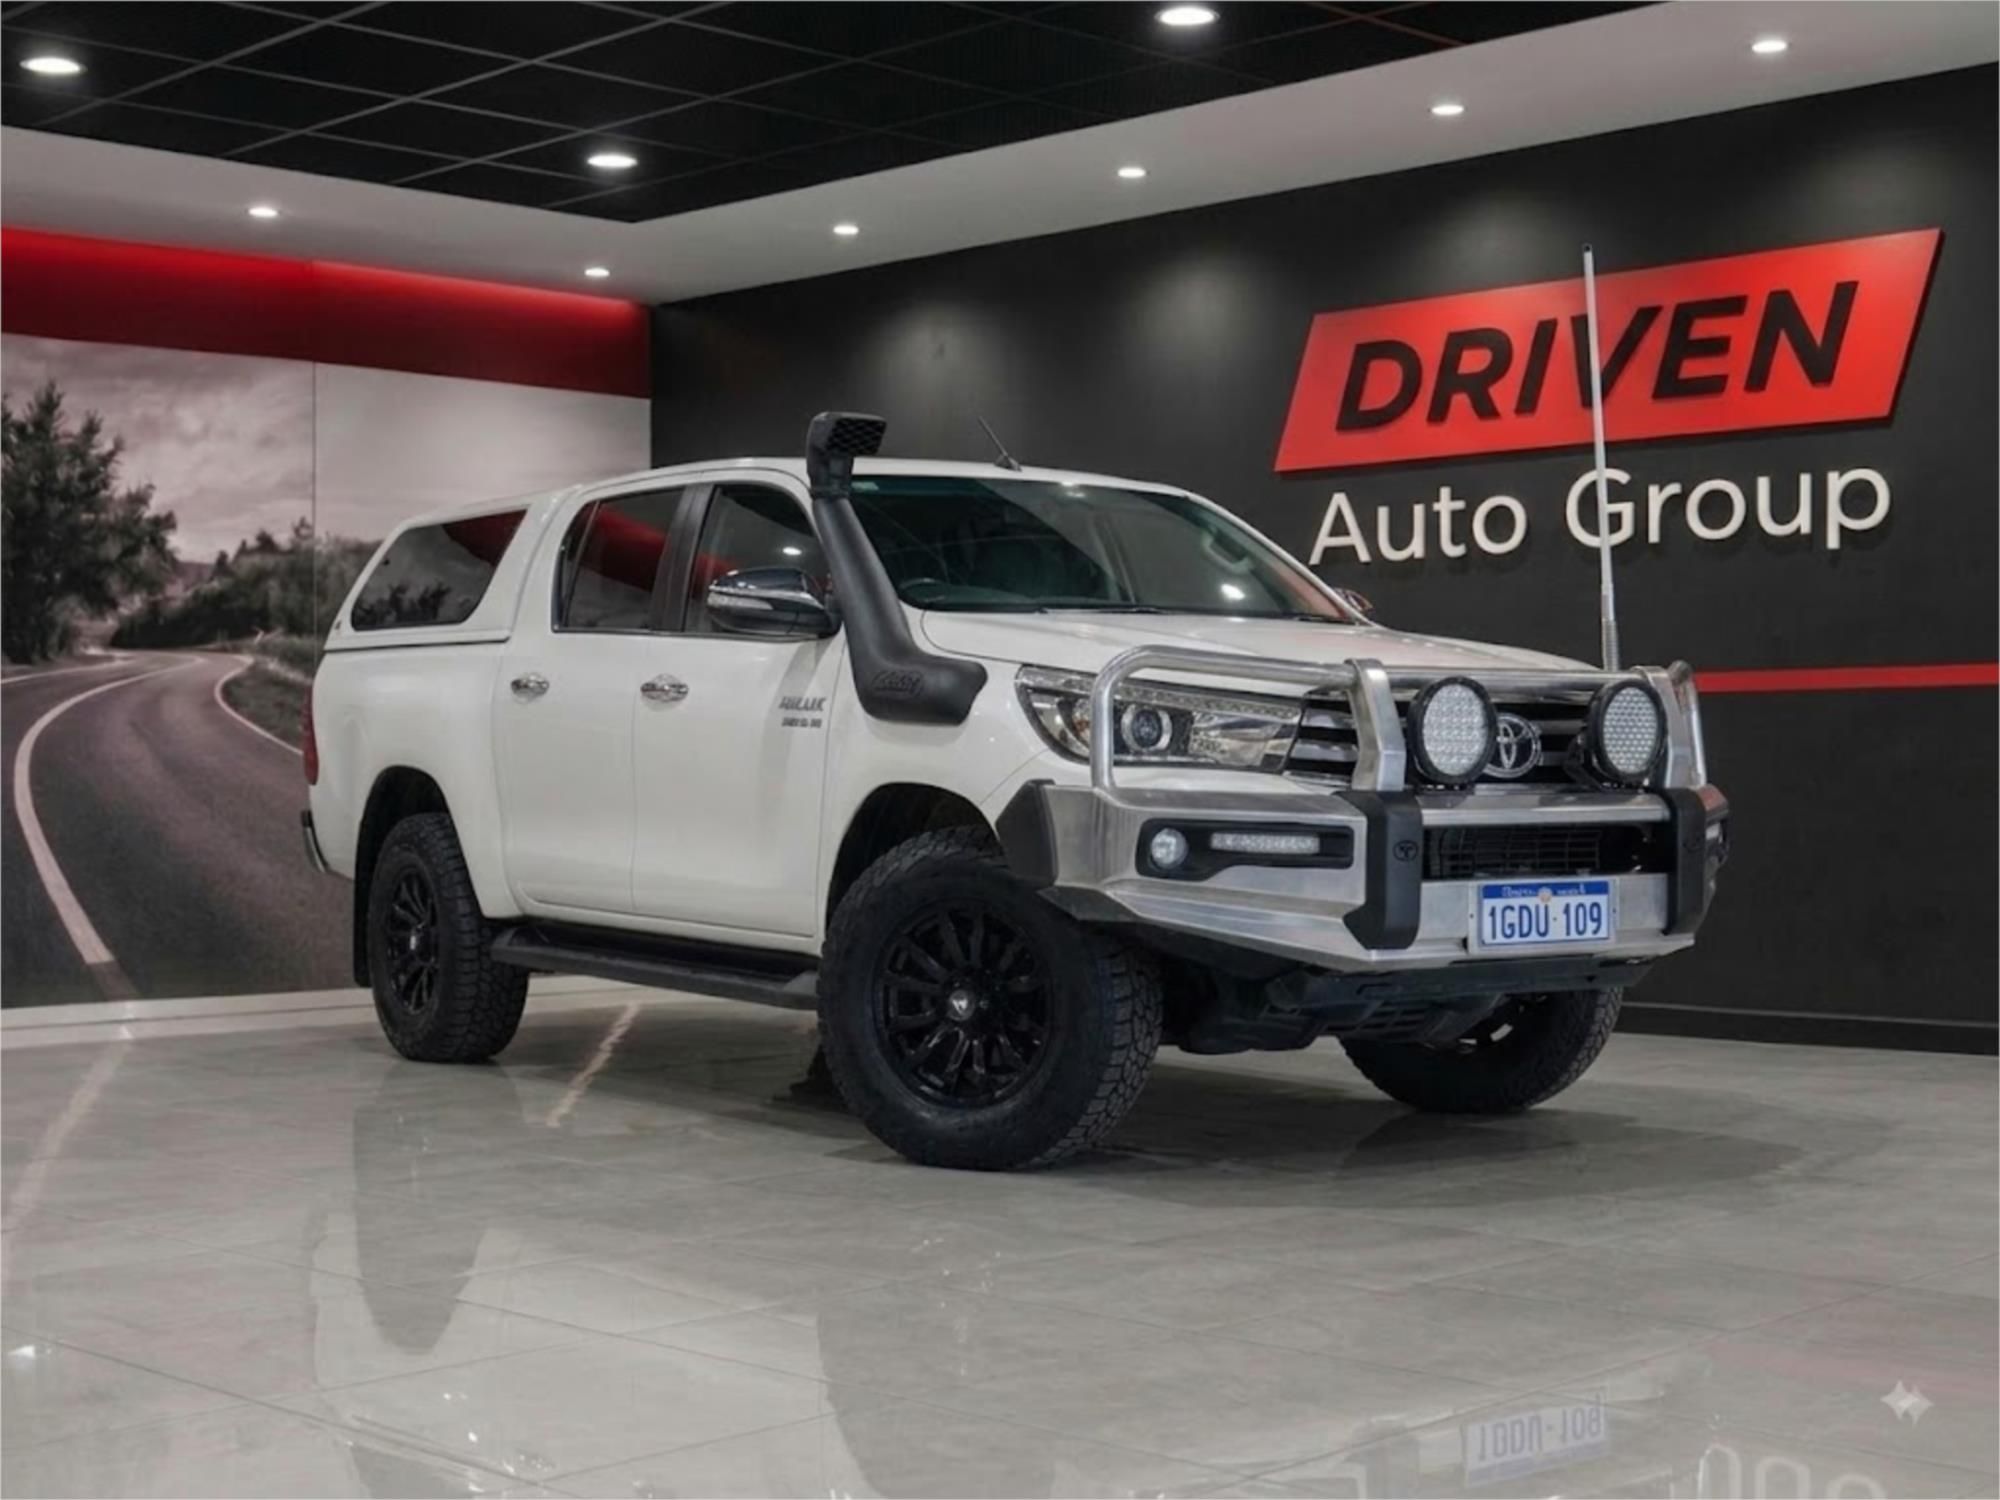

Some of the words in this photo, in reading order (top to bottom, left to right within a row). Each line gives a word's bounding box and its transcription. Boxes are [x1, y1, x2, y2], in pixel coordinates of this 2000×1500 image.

[1335, 280, 1860, 432] DRIVEN
[1309, 485, 1528, 566] Auto
[1564, 466, 1892, 551] Group
